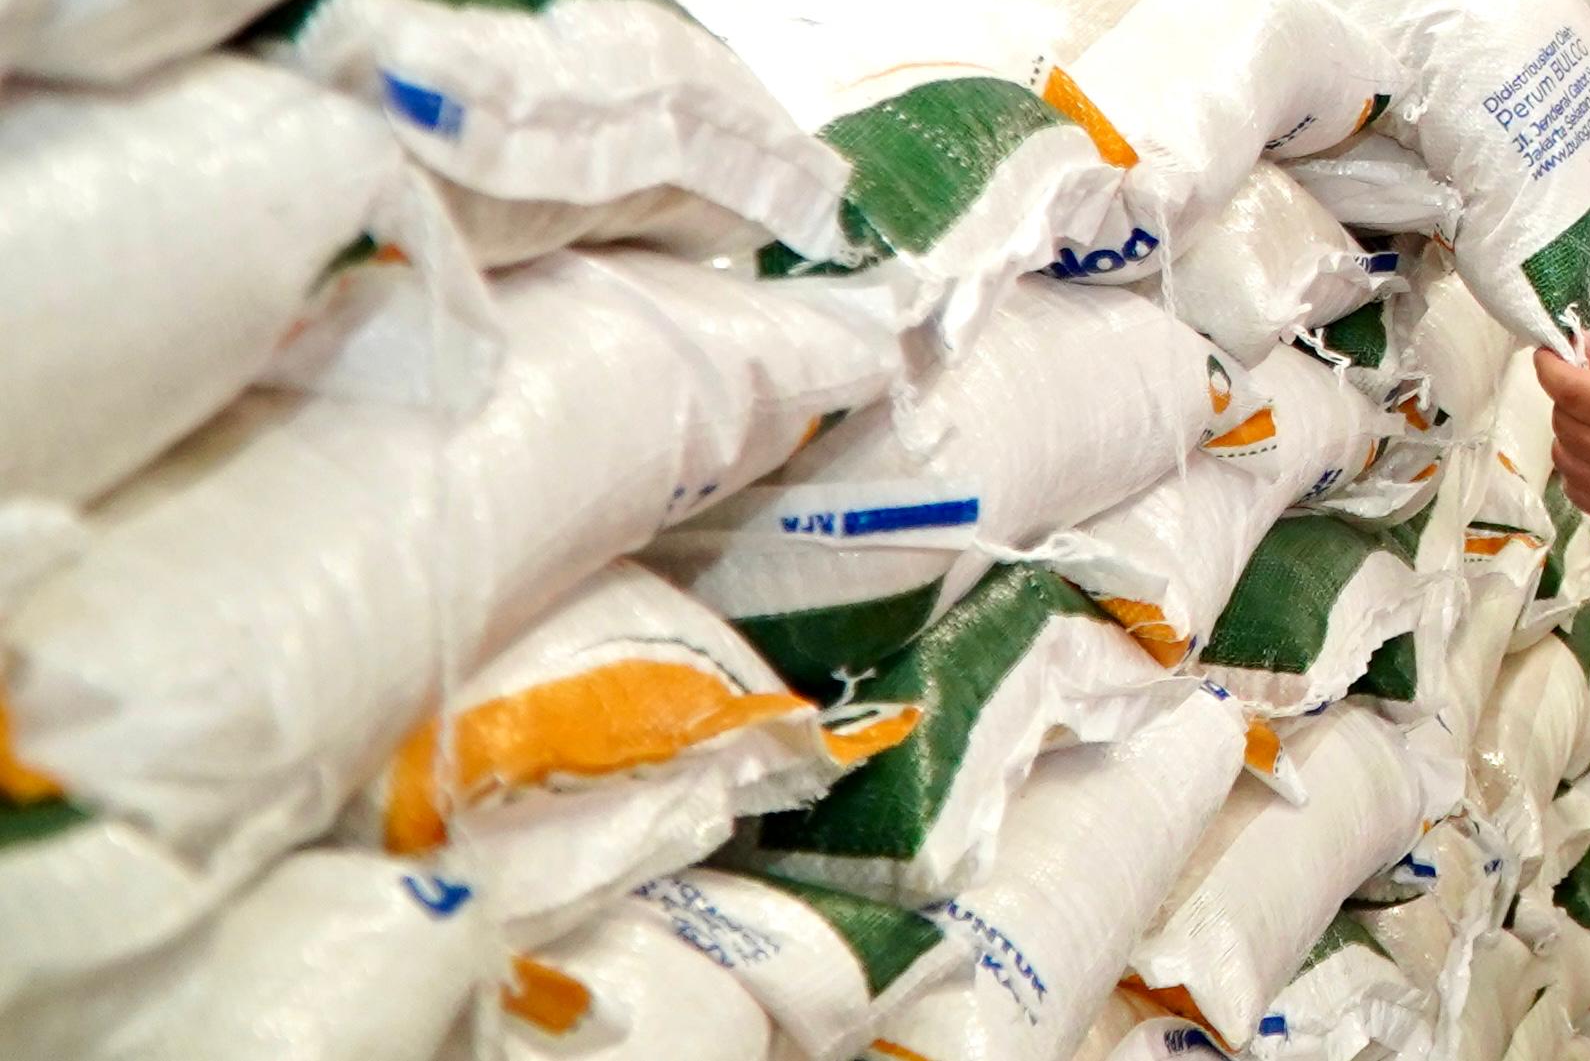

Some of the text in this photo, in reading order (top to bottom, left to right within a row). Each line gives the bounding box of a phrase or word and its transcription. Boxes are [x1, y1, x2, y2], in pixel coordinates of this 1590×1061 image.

[1495, 37, 1589, 132] Perum BULOG
[1530, 90, 1573, 137] Jenderal
[1522, 125, 1568, 168] Jakarta
